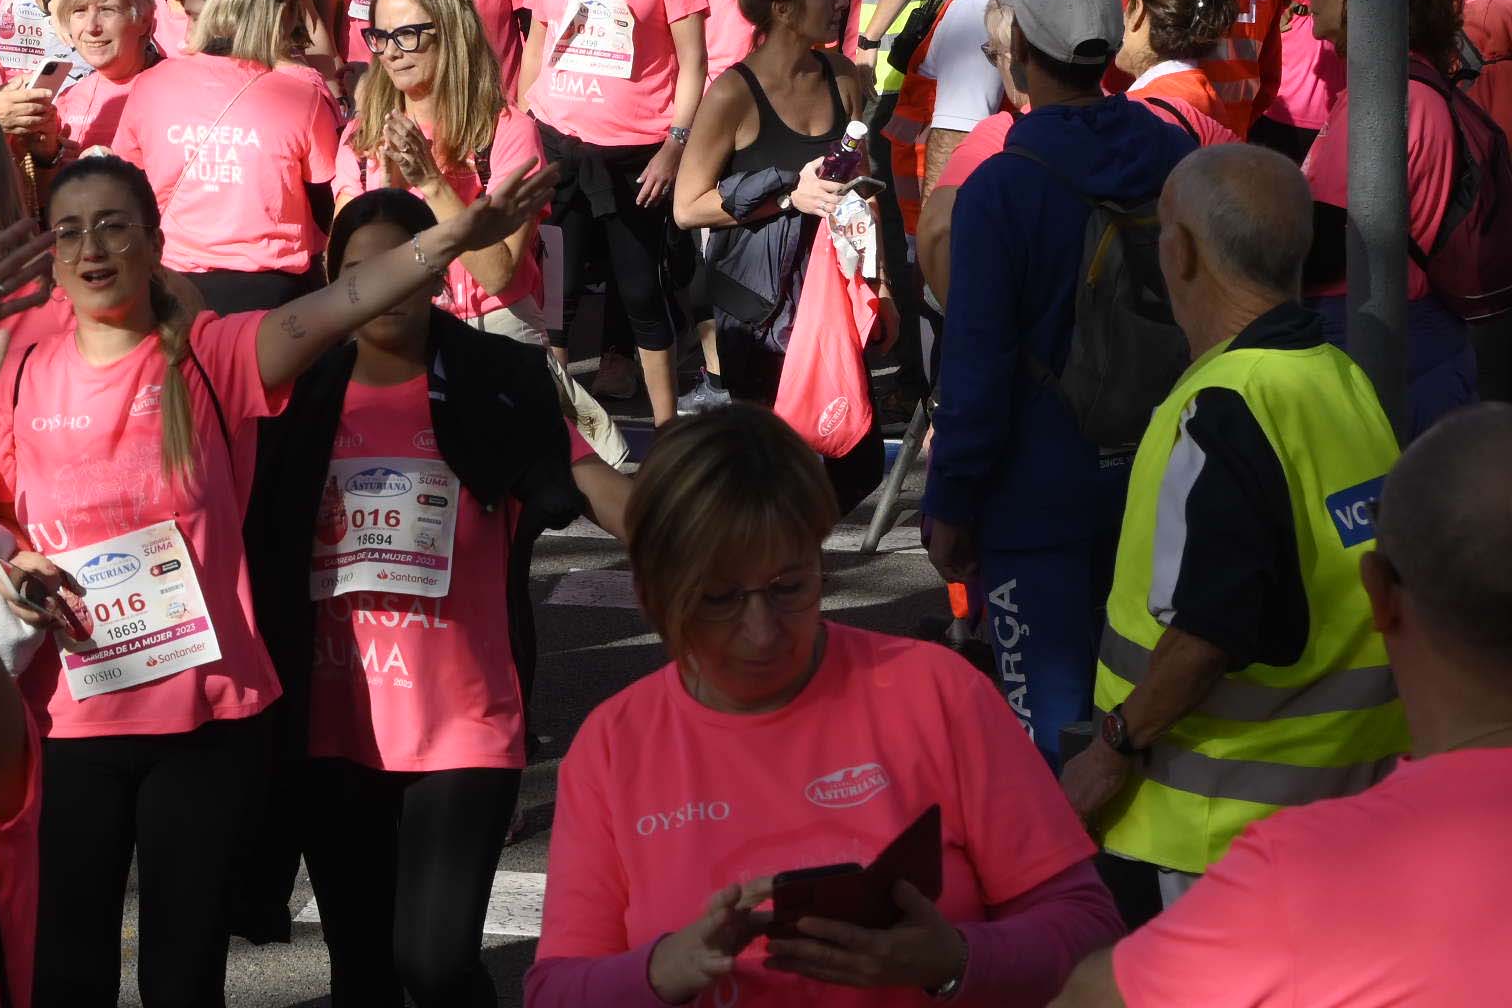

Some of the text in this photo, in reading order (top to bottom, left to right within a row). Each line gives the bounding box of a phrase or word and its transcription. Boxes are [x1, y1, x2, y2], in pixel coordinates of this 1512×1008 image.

[18, 24, 43, 37] 016
[20, 37, 40, 46] 21079
[551, 72, 602, 96] SUMA
[167, 125, 261, 147] CARRERA
[184, 144, 238, 163] DE LA
[31, 414, 91, 432] OYSHO
[351, 480, 407, 491] ASTURIANA
[418, 476, 448, 487] SUMA
[351, 508, 401, 528] 016
[143, 541, 174, 557] SUMA
[357, 533, 392, 546] 18694
[357, 552, 365, 561] DE
[367, 551, 379, 559] LA
[381, 552, 413, 562] MUJER
[81, 563, 137, 585] ASTURIANA
[390, 571, 438, 586] Santander
[94, 593, 146, 622] 016
[107, 620, 147, 640] 18693
[116, 646, 127, 654] DE
[129, 641, 140, 650] LA
[142, 632, 172, 647] MUJER
[175, 623, 196, 635] 2023
[158, 643, 206, 664] Santander
[84, 668, 122, 685] OYSHO
[812, 773, 886, 801] ASTURIANA
[637, 801, 730, 835] OYSHO
